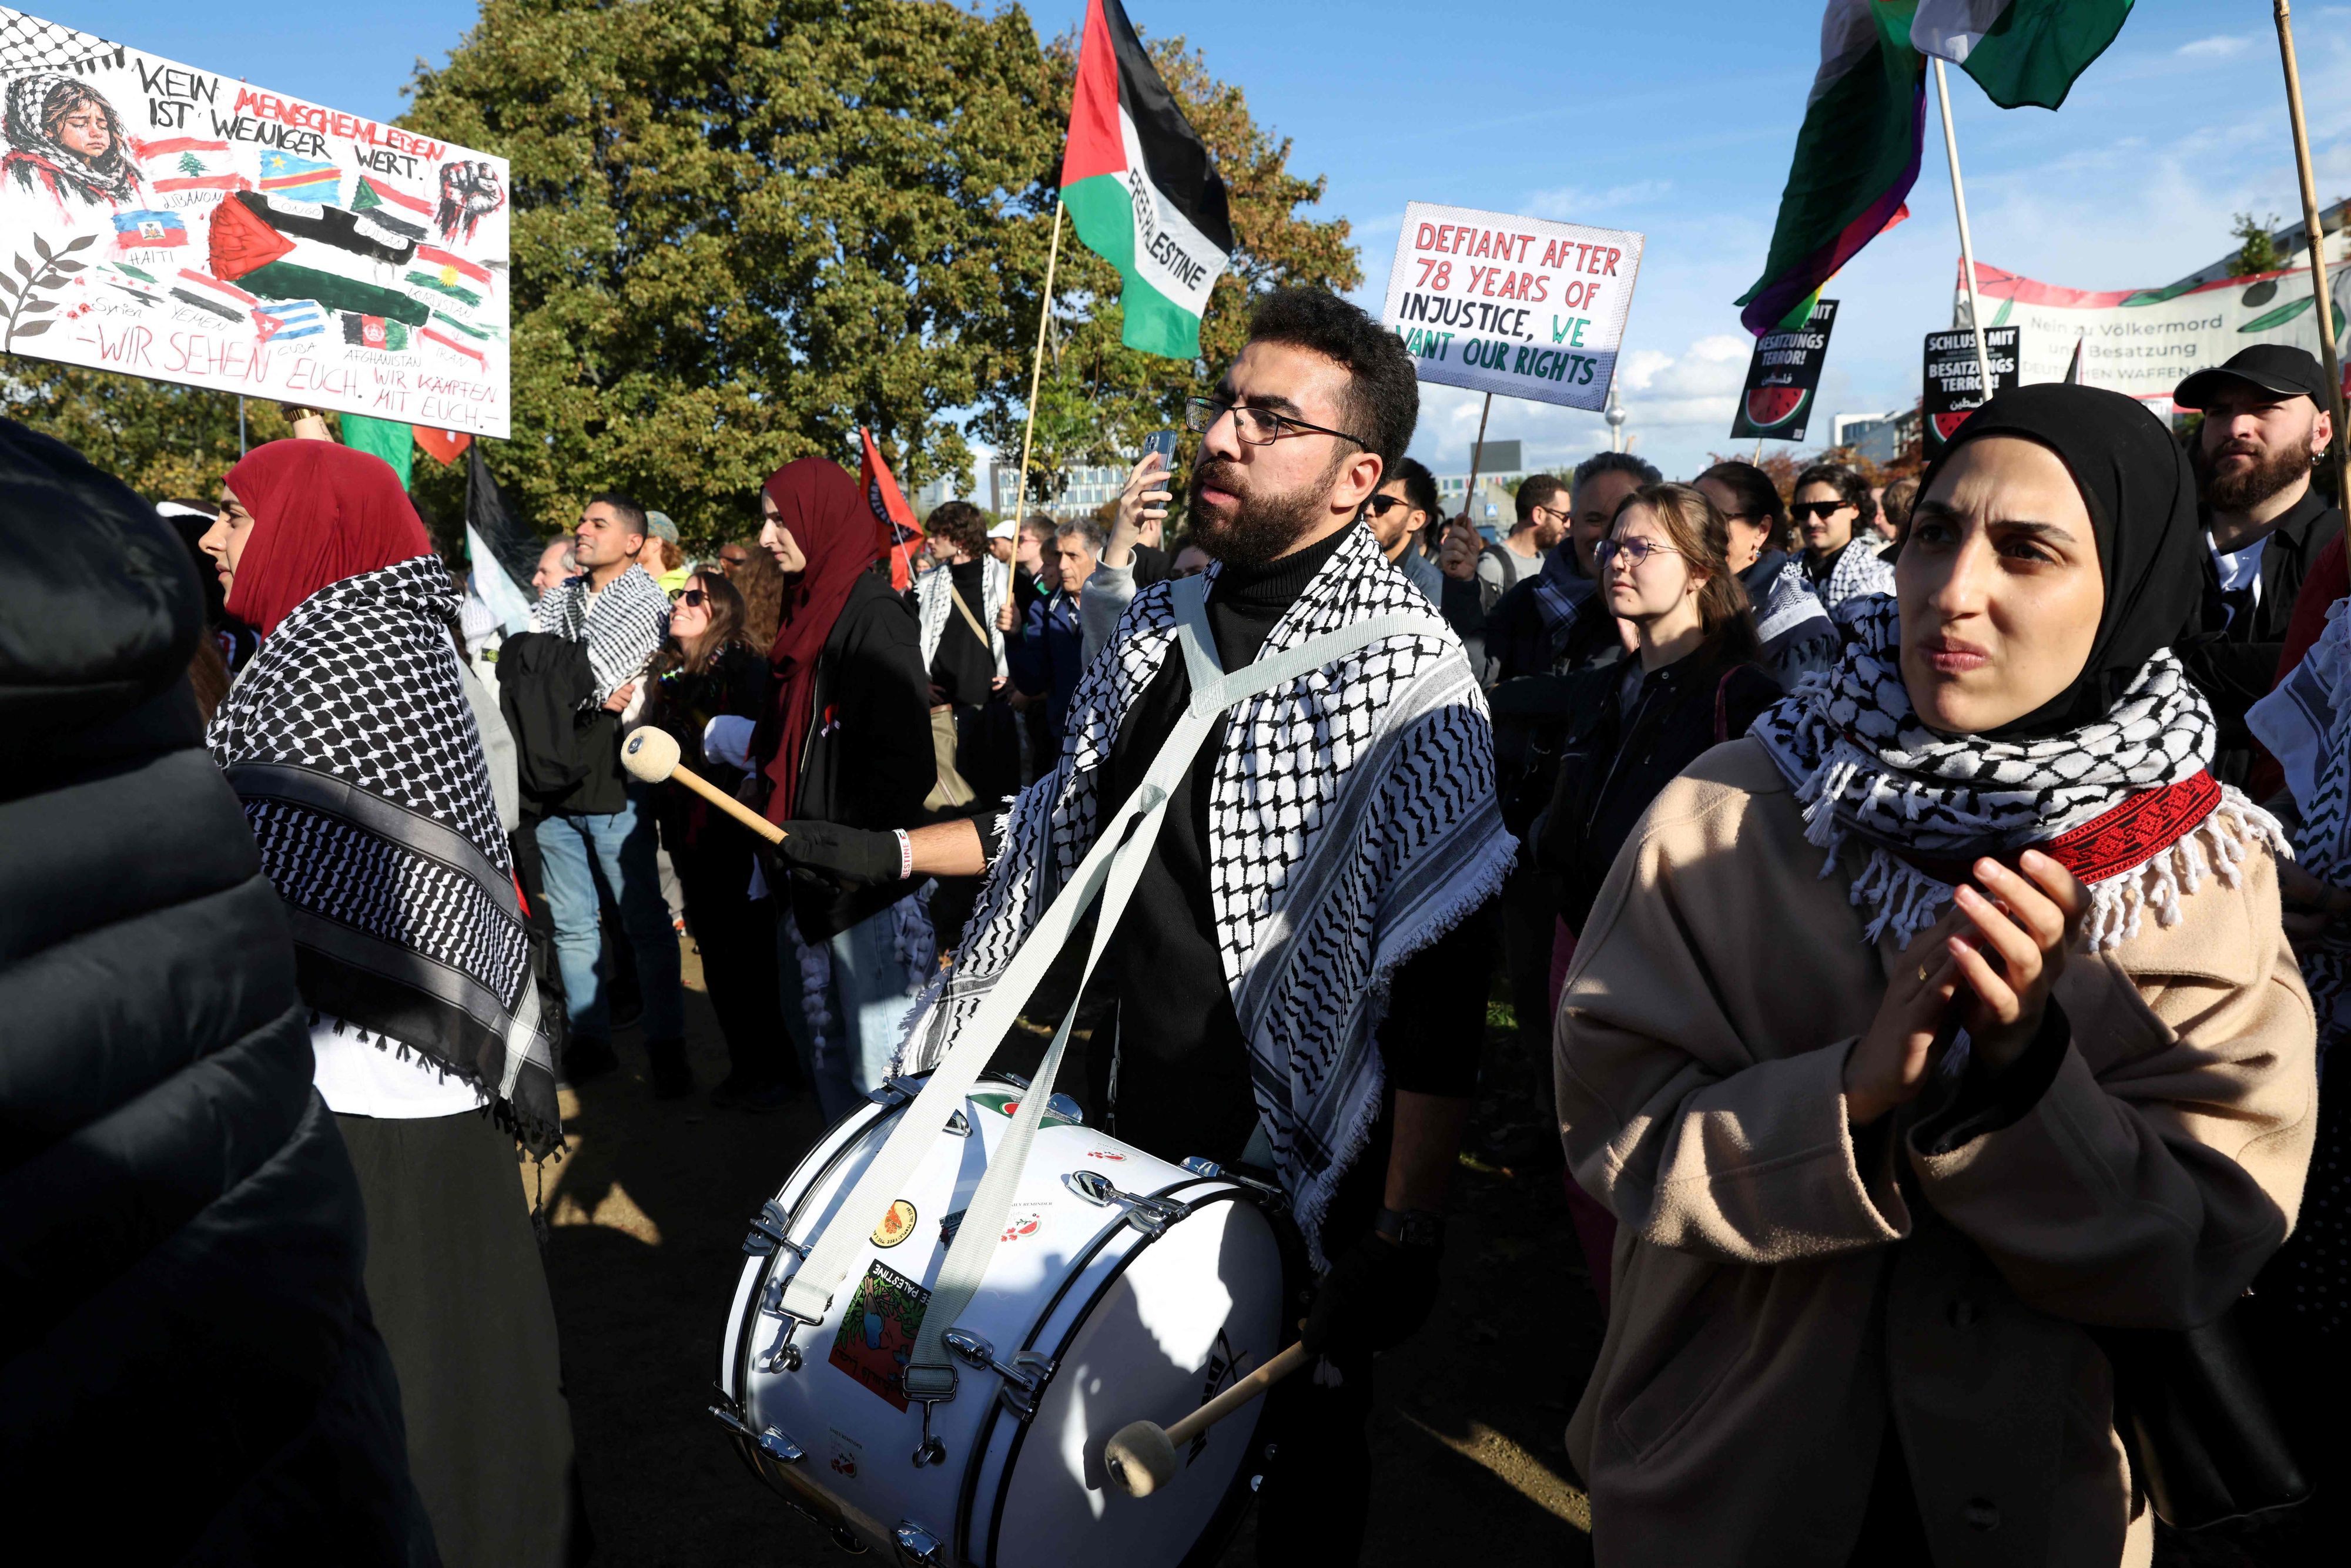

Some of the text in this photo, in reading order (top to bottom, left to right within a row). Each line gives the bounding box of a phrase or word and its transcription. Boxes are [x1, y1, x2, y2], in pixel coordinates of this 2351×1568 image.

[135, 58, 446, 161] KEIN MENSCHENLEBEN
[149, 98, 423, 180] IST WENIGER WERT.
[164, 190, 223, 209] LIBANON
[270, 200, 321, 216] CONGO
[359, 223, 406, 250] SUDAN
[1128, 167, 1207, 292] FREE PALESTINE
[129, 250, 174, 265] HAITI
[1415, 223, 1621, 276] DEFIANT AFTER
[1416, 258, 1600, 310] 78 YEARS OF
[92, 297, 142, 319] Syrien
[407, 287, 473, 318] KURDISTAN
[170, 304, 228, 331] YEMEN
[1399, 292, 1590, 348] INJUSTICE, WE
[2031, 316, 2067, 334] Nein
[2099, 314, 2223, 337] Völkermord
[278, 342, 317, 356] CUBA
[1757, 333, 1824, 351] BESATZUNGS
[1928, 333, 1986, 351] SCHLUS
[1988, 330, 2016, 346] MIT
[2088, 342, 2198, 357] Besatzung
[165, 332, 270, 383] SEHEN
[344, 350, 422, 367] AFGHANISTAN
[436, 347, 468, 367] IRAN
[1463, 338, 1509, 371] OUR
[1513, 346, 1597, 386] RIGHTS
[1761, 350, 1807, 366] TERROR!
[374, 367, 497, 403] WIR KÄMPFEN
[2118, 366, 2191, 380] WAFFEN
[373, 388, 412, 413] MIT
[872, 1264, 919, 1298] PALESTINE
[829, 1426, 840, 1436] DAILY
[841, 1434, 863, 1450] REMINDER
